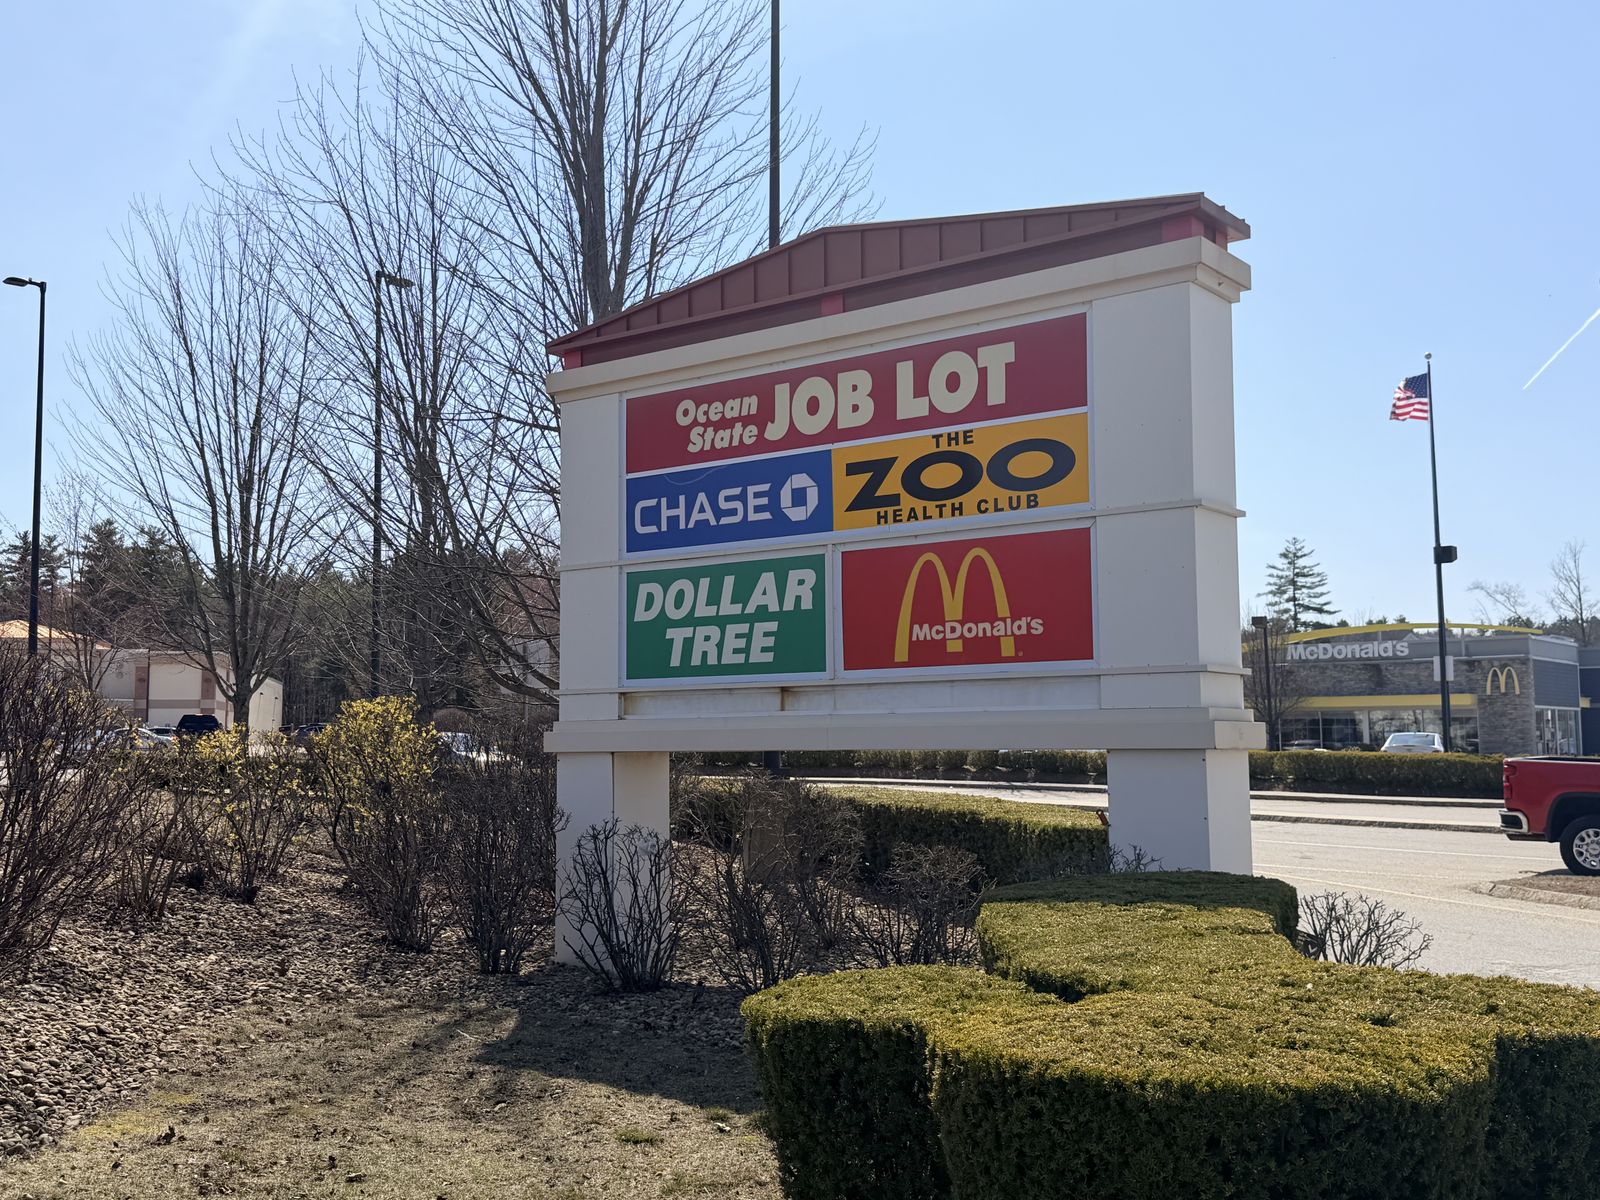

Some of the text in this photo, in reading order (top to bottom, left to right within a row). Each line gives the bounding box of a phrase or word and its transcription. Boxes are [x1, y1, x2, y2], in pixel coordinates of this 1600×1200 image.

[764, 341, 1015, 441] JOB LOT
[676, 394, 758, 427] Ocean
[687, 422, 758, 453] State
[931, 429, 975, 449] THE
[844, 438, 1076, 512] ZOO
[634, 482, 772, 534] CHASE
[876, 493, 1040, 525] HEALTH CLUB
[633, 568, 816, 622] DOLLAR
[665, 621, 779, 667] TREE
[911, 616, 1044, 641] McDonald's
[1286, 640, 1409, 660] McDonald's
